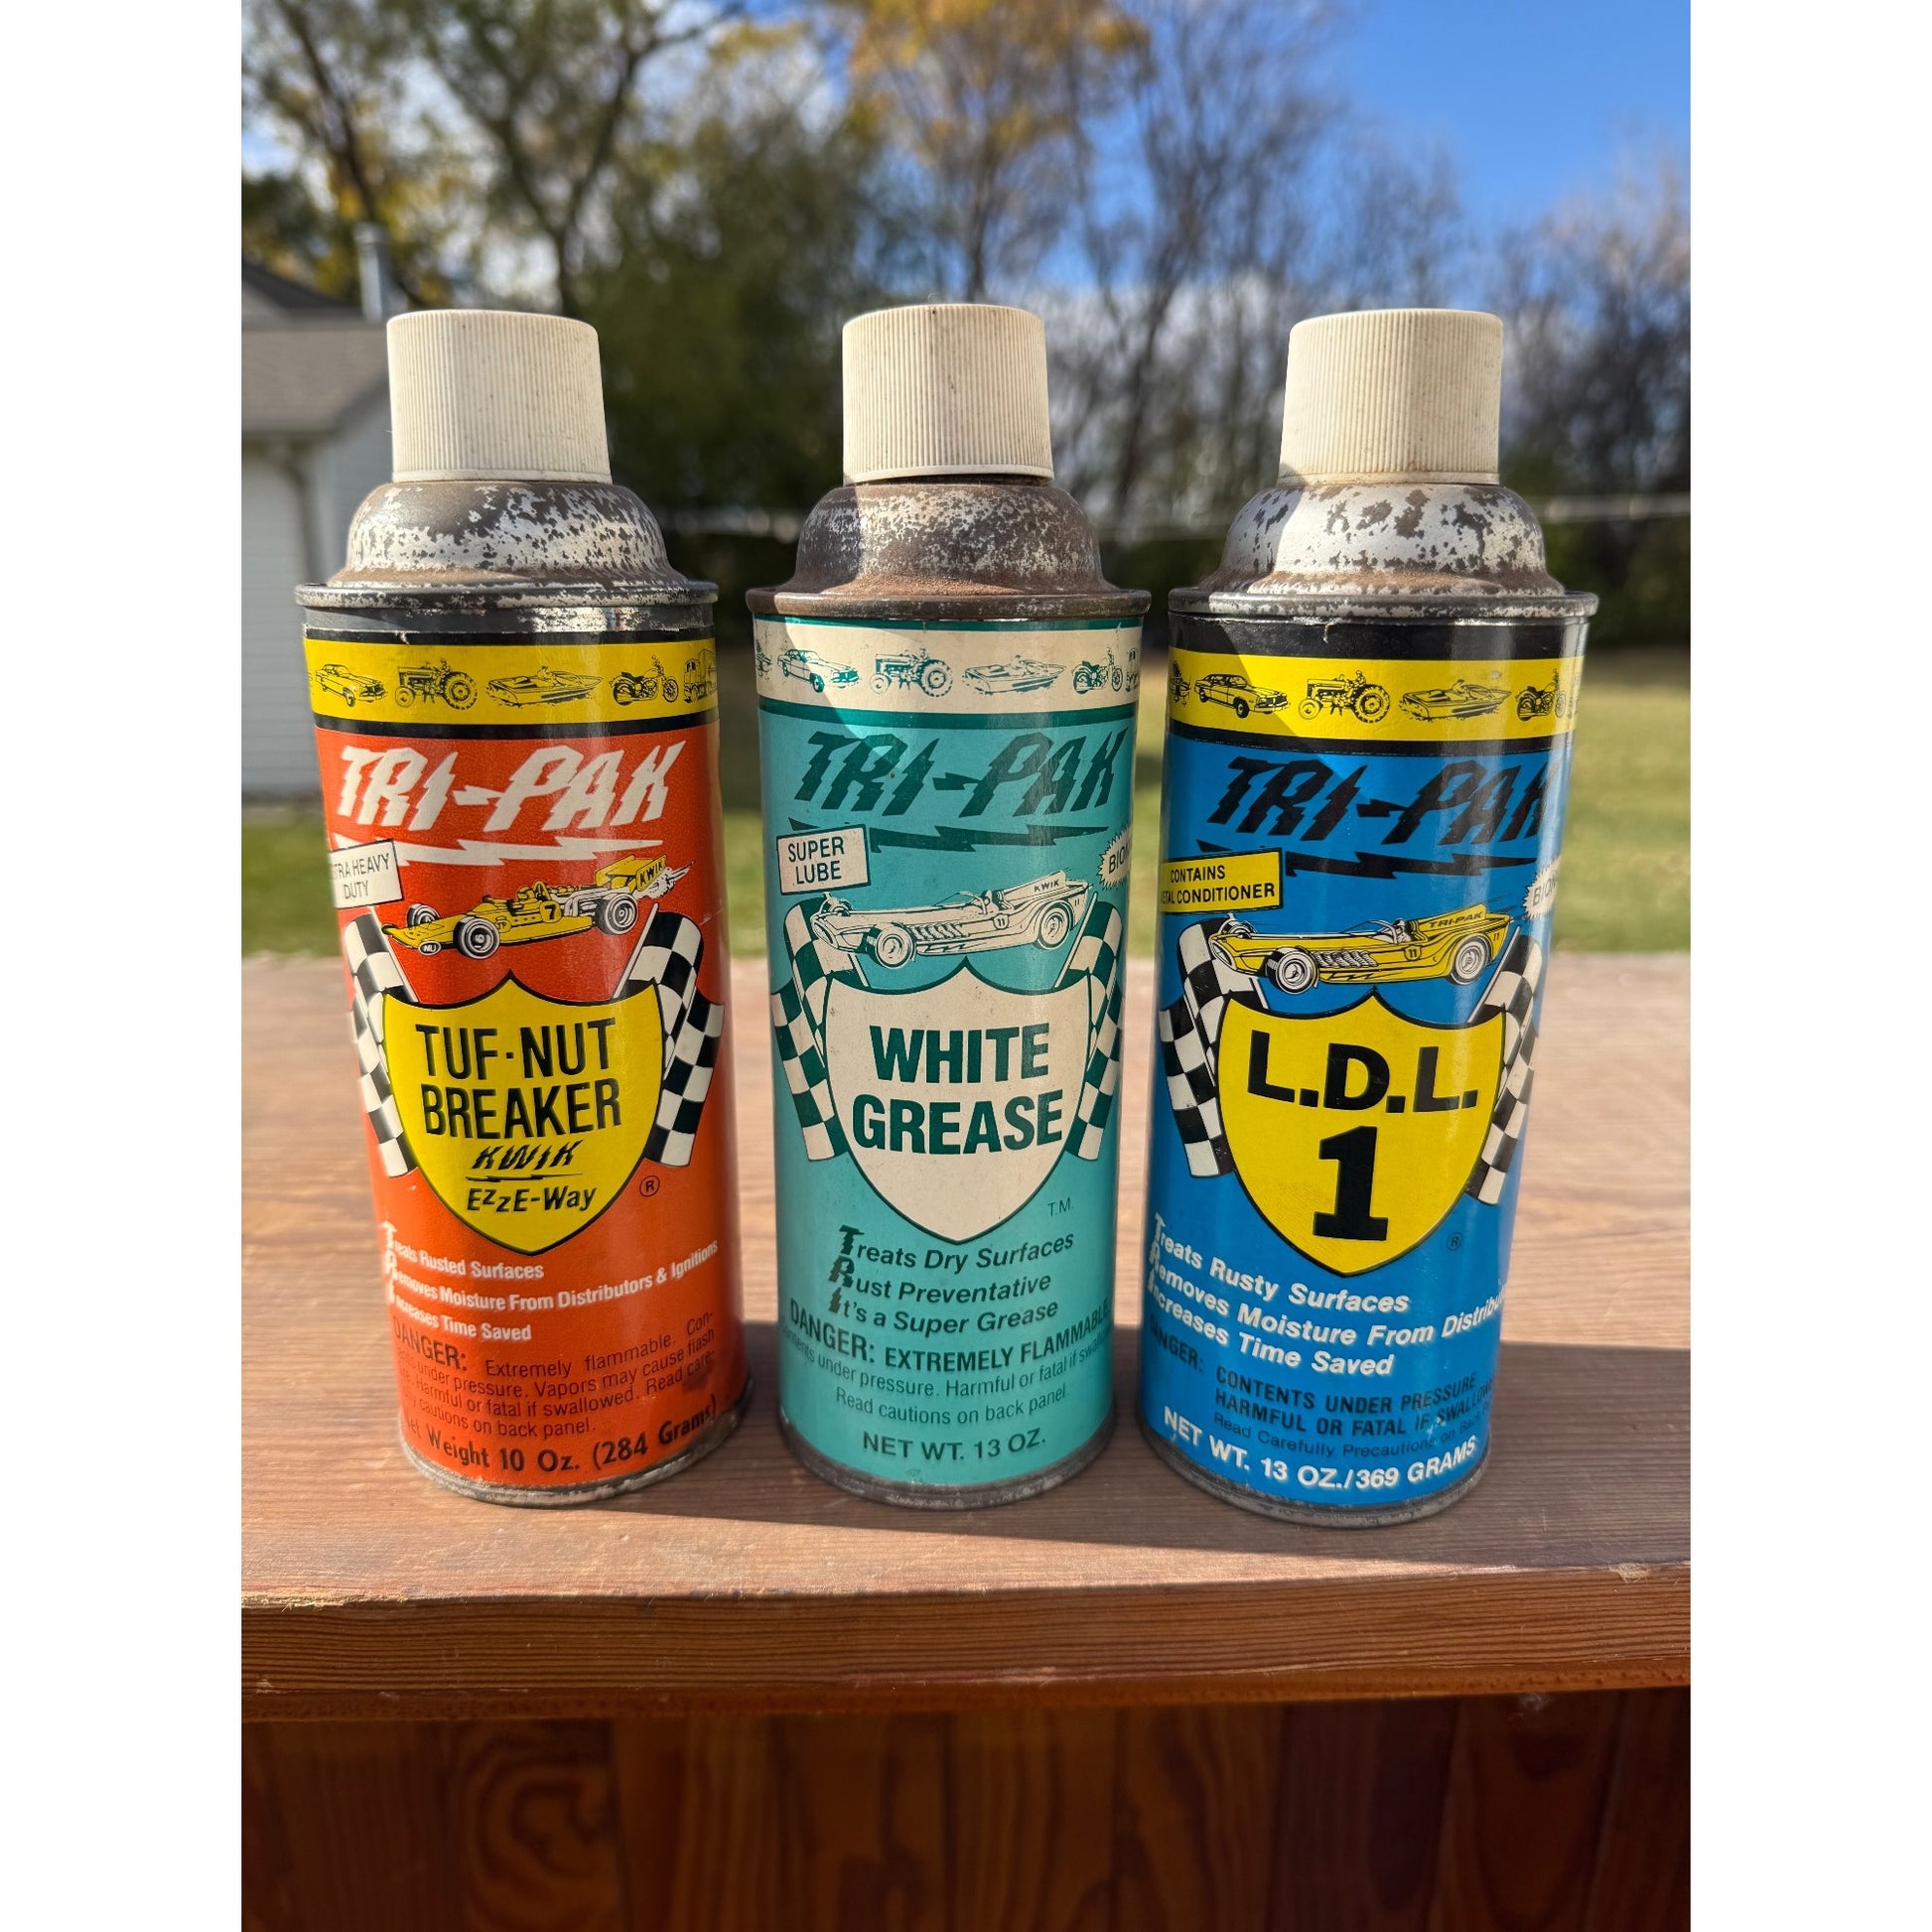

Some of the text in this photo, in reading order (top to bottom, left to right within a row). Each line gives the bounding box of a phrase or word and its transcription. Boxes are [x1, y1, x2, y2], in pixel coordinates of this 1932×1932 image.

[337, 741, 686, 832] TRI-PAK
[794, 726, 1129, 818] TRI-PAK
[1207, 756, 1559, 846] TRI-PAK
[351, 853, 390, 877] HEAVY
[639, 857, 666, 888] KWIK
[788, 836, 845, 863] SUPER
[795, 860, 842, 885] LUBE
[1170, 865, 1226, 884] CONTAINS
[343, 881, 369, 899] DUTY
[544, 904, 556, 919] 7
[1034, 879, 1060, 893] KWIK
[1176, 883, 1275, 904] CONDITIONER
[869, 1023, 1050, 1084] WHITE
[1247, 1030, 1478, 1114] L.D.L.
[421, 1078, 621, 1140] BREAKER
[852, 1088, 1063, 1155] GREASE
[472, 1139, 585, 1171] KWIK
[1312, 1125, 1389, 1241] 1
[420, 1250, 467, 1276] Rusted
[471, 1261, 545, 1279] Surfaces
[839, 1224, 1074, 1275] Treats Dry Surfaces
[1155, 1212, 1410, 1312] Treats Rusty Surfaces
[440, 1285, 506, 1311] Moisture
[509, 1294, 554, 1311] From
[558, 1274, 653, 1309] Distributors
[656, 1267, 667, 1284] &
[670, 1240, 718, 1279] Ignitions
[828, 1255, 1051, 1305] Rust Preventative
[1149, 1242, 1230, 1316] Removes
[1237, 1303, 1356, 1345] Moisture
[1366, 1324, 1435, 1346] From
[441, 1314, 478, 1337] Time
[481, 1322, 532, 1340] Saved
[790, 1297, 1110, 1373] DANGER: EXTREMELY FLAMMABLE
[828, 1287, 1058, 1338] It's a Super Grease
[1148, 1269, 1395, 1376] Increases Time Saved
[393, 1316, 468, 1371] DANGER:
[485, 1359, 572, 1378] Extremely
[686, 1311, 714, 1336] Con-
[418, 1362, 451, 1385] under
[454, 1376, 528, 1398] pressure.
[534, 1378, 597, 1399] Vapors
[602, 1368, 637, 1389] may
[642, 1349, 685, 1376] cause
[687, 1328, 715, 1356] flash
[416, 1375, 463, 1408] Harmful
[467, 1399, 483, 1412] or
[486, 1399, 521, 1417] fatal
[527, 1400, 537, 1417] if
[542, 1385, 640, 1417] swallowed.
[646, 1366, 683, 1395] Read
[818, 1353, 857, 1381] under
[860, 1371, 939, 1397] pressure.
[946, 1373, 1016, 1397] Harmful
[1019, 1373, 1035, 1388] or
[1038, 1361, 1067, 1381] fatal
[1069, 1349, 1078, 1369] if
[1216, 1365, 1315, 1410] CONTENTS
[1324, 1394, 1392, 1416] UNDER
[1401, 1371, 1477, 1412] PRESSURE
[419, 1397, 470, 1429] cautions
[473, 1418, 492, 1433] on
[497, 1420, 537, 1437] back
[543, 1418, 596, 1440] panel.
[836, 1384, 1068, 1425] Read cautions on back panel.
[1215, 1387, 1307, 1433] HARMFUL
[1315, 1417, 1341, 1436] OR
[1351, 1418, 1407, 1437] FATAL
[1415, 1413, 1431, 1431] IF
[426, 1423, 490, 1467] Weight
[499, 1448, 524, 1471] 10
[537, 1449, 580, 1471] Oz.
[593, 1433, 649, 1470] (284
[658, 1393, 717, 1446] Grams)
[863, 1428, 1045, 1461] NET WT. 13 OZ.
[1164, 1406, 1203, 1447] NET
[1208, 1435, 1251, 1471] WT.
[1260, 1457, 1289, 1481] 13
[1407, 1435, 1477, 1482] GRAMS
[1213, 1412, 1252, 1438] Read
[1257, 1430, 1335, 1458] Carefully
[1343, 1437, 1437, 1458] Precautions
[1442, 1429, 1456, 1445] on
